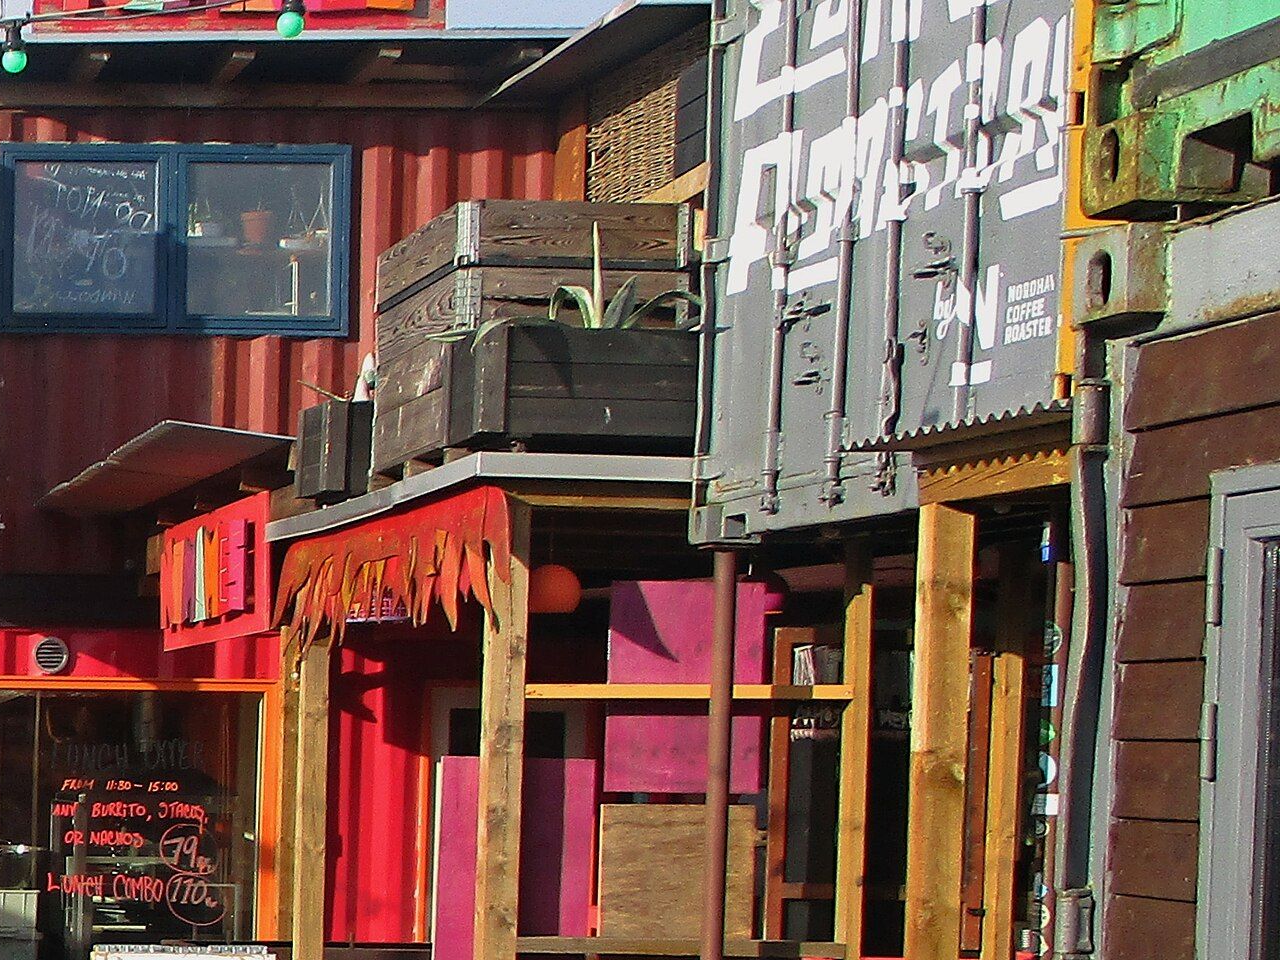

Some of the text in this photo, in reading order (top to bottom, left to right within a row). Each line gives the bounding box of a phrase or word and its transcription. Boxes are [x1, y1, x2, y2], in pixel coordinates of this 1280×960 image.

[1005, 298, 1045, 324] COFFEE
[61, 779, 94, 791] FROM
[147, 781, 179, 792] 15:00
[51, 801, 79, 816] ANY
[64, 831, 84, 845] OR
[47, 872, 104, 898] LUNCH
[113, 874, 164, 903] COMBO
